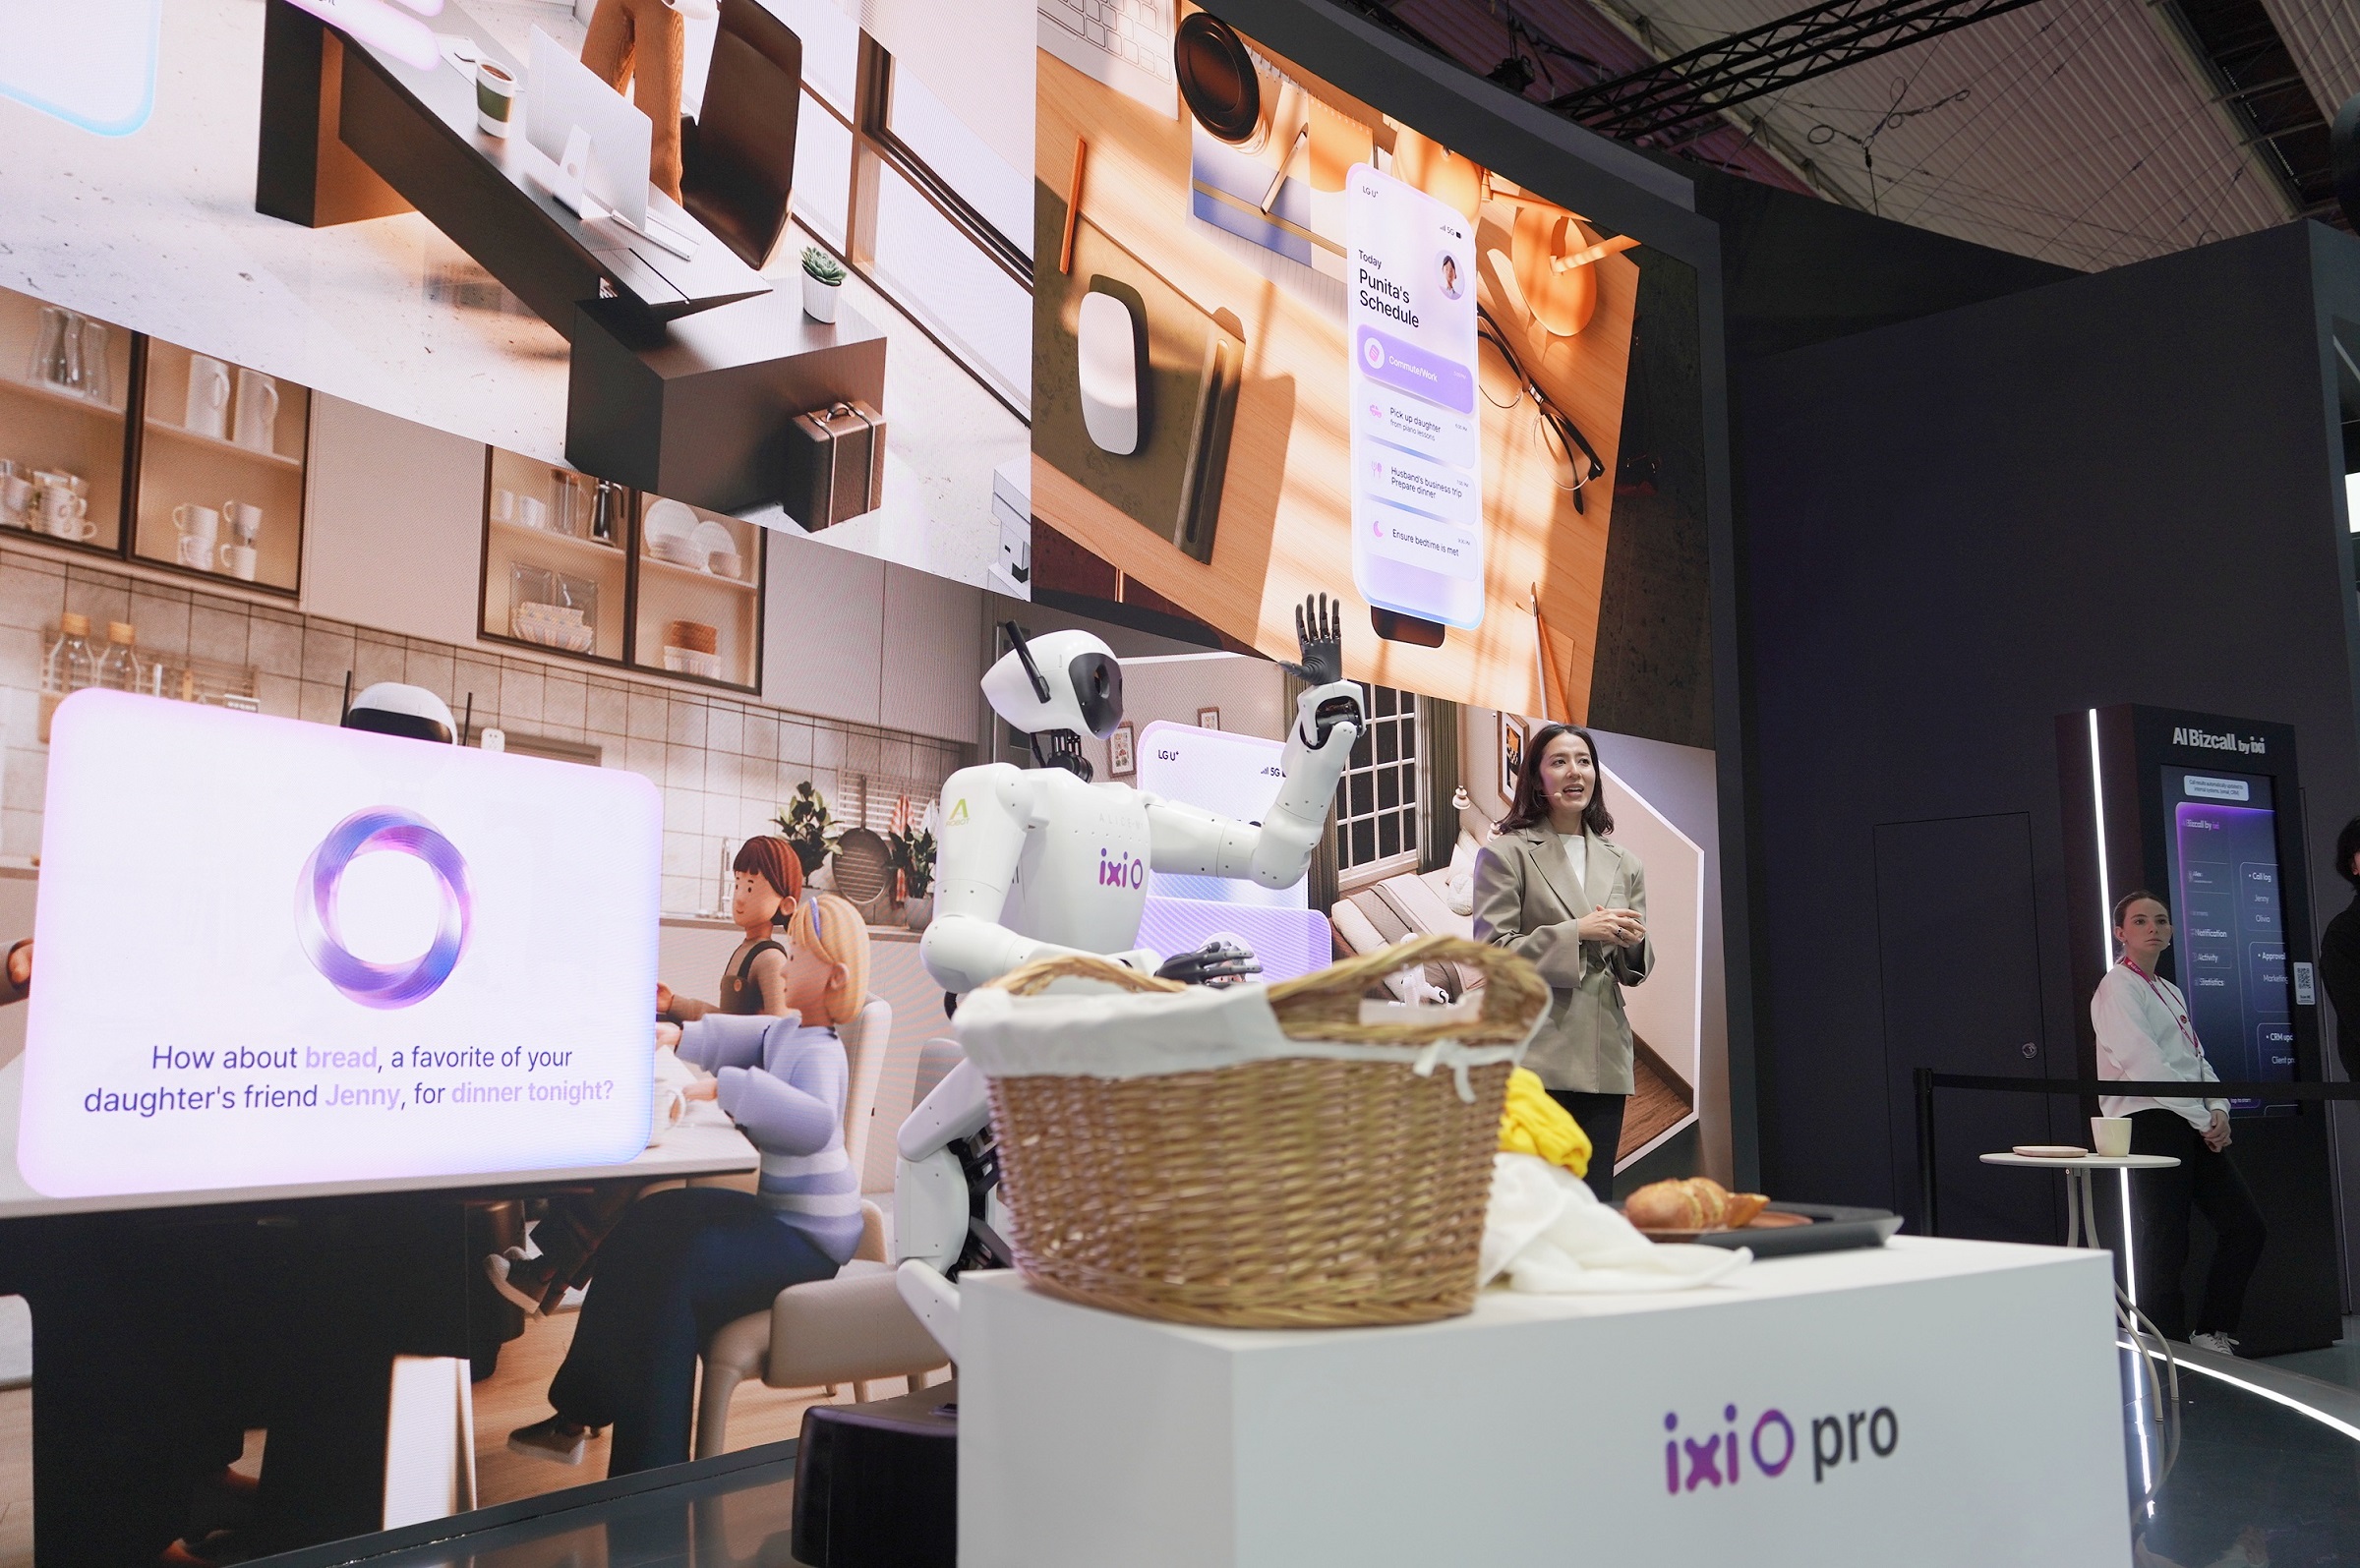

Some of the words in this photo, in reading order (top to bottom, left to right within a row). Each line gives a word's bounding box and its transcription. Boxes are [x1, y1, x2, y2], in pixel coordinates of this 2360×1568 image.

[1363, 186, 1371, 195] LG
[1446, 227, 1455, 236] 5G
[1358, 249, 1383, 270] Today
[1359, 267, 1410, 304] Punita's
[1359, 289, 1420, 328] Schedule
[1390, 407, 1404, 418] Pick
[1405, 414, 1413, 424] up
[1414, 416, 1441, 433] daughter
[1390, 419, 1403, 429] from
[1403, 423, 1417, 435] piano
[1417, 430, 1436, 441] lessons
[1391, 466, 1424, 485] Husband's
[1424, 477, 1451, 494] business
[1452, 487, 1463, 498] trip
[1391, 476, 1416, 493] Prepare
[1416, 485, 1436, 498] dinner
[1392, 528, 1414, 543] Ensure
[1415, 535, 1441, 552] bedtime
[1441, 544, 1446, 553] is
[1447, 546, 1460, 557] met
[2173, 727, 2188, 746] AI
[2189, 728, 2238, 751] Bizcall
[2238, 739, 2250, 755] by
[2249, 736, 2266, 754] ixi
[1158, 749, 1169, 760] LG
[1270, 767, 1280, 777] 5G
[2205, 820, 2212, 831] by
[2252, 872, 2261, 881] Call
[2263, 873, 2272, 883] log
[2254, 895, 2270, 904] Jenny
[2255, 914, 2271, 923] Olivia
[2195, 929, 2228, 938] Notification
[2197, 953, 2218, 963] Activity
[2262, 952, 2286, 961] Approval
[2199, 978, 2225, 987] Statistics
[2270, 1033, 2283, 1041] CRM
[152, 1045, 215, 1070] How
[222, 1045, 298, 1069] about
[306, 1045, 383, 1074] bread,
[391, 1051, 404, 1068] a
[411, 1045, 495, 1068] favorite
[501, 1045, 522, 1068] of
[528, 1050, 572, 1073] your
[2272, 1056, 2287, 1064] Client
[84, 1085, 236, 1118] daughter's
[244, 1083, 318, 1109] friend
[325, 1084, 406, 1111] Jenny,
[414, 1082, 445, 1105] for
[451, 1081, 522, 1103] dinner
[528, 1079, 615, 1106] tonight?
[1811, 1406, 1899, 1484] pro
